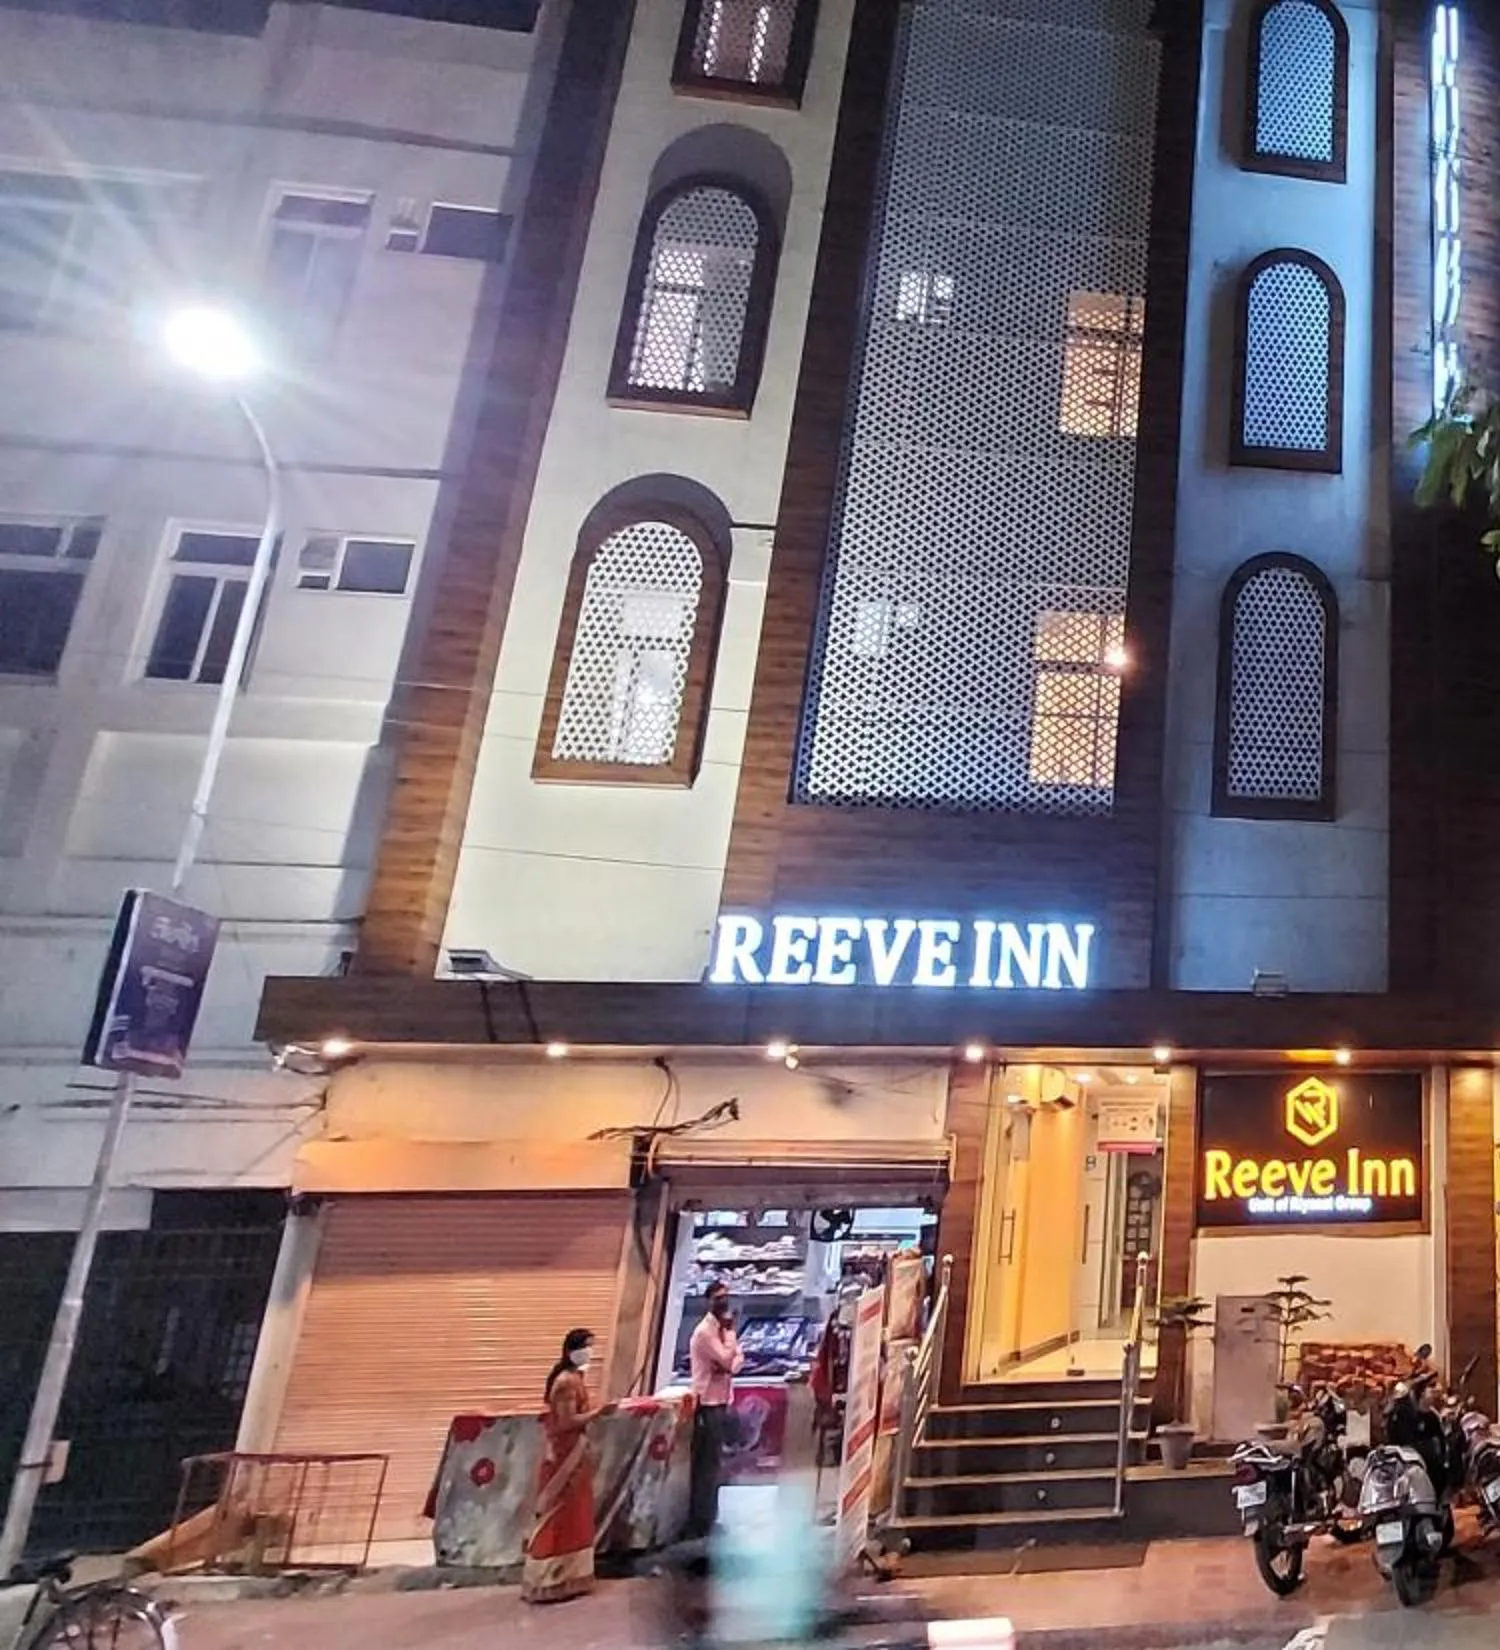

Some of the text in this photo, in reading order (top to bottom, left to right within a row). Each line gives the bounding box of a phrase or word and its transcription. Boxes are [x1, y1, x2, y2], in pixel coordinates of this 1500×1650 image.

[710, 915, 1095, 989] REEVE INN
[1204, 1147, 1416, 1201] Reeve Inn
